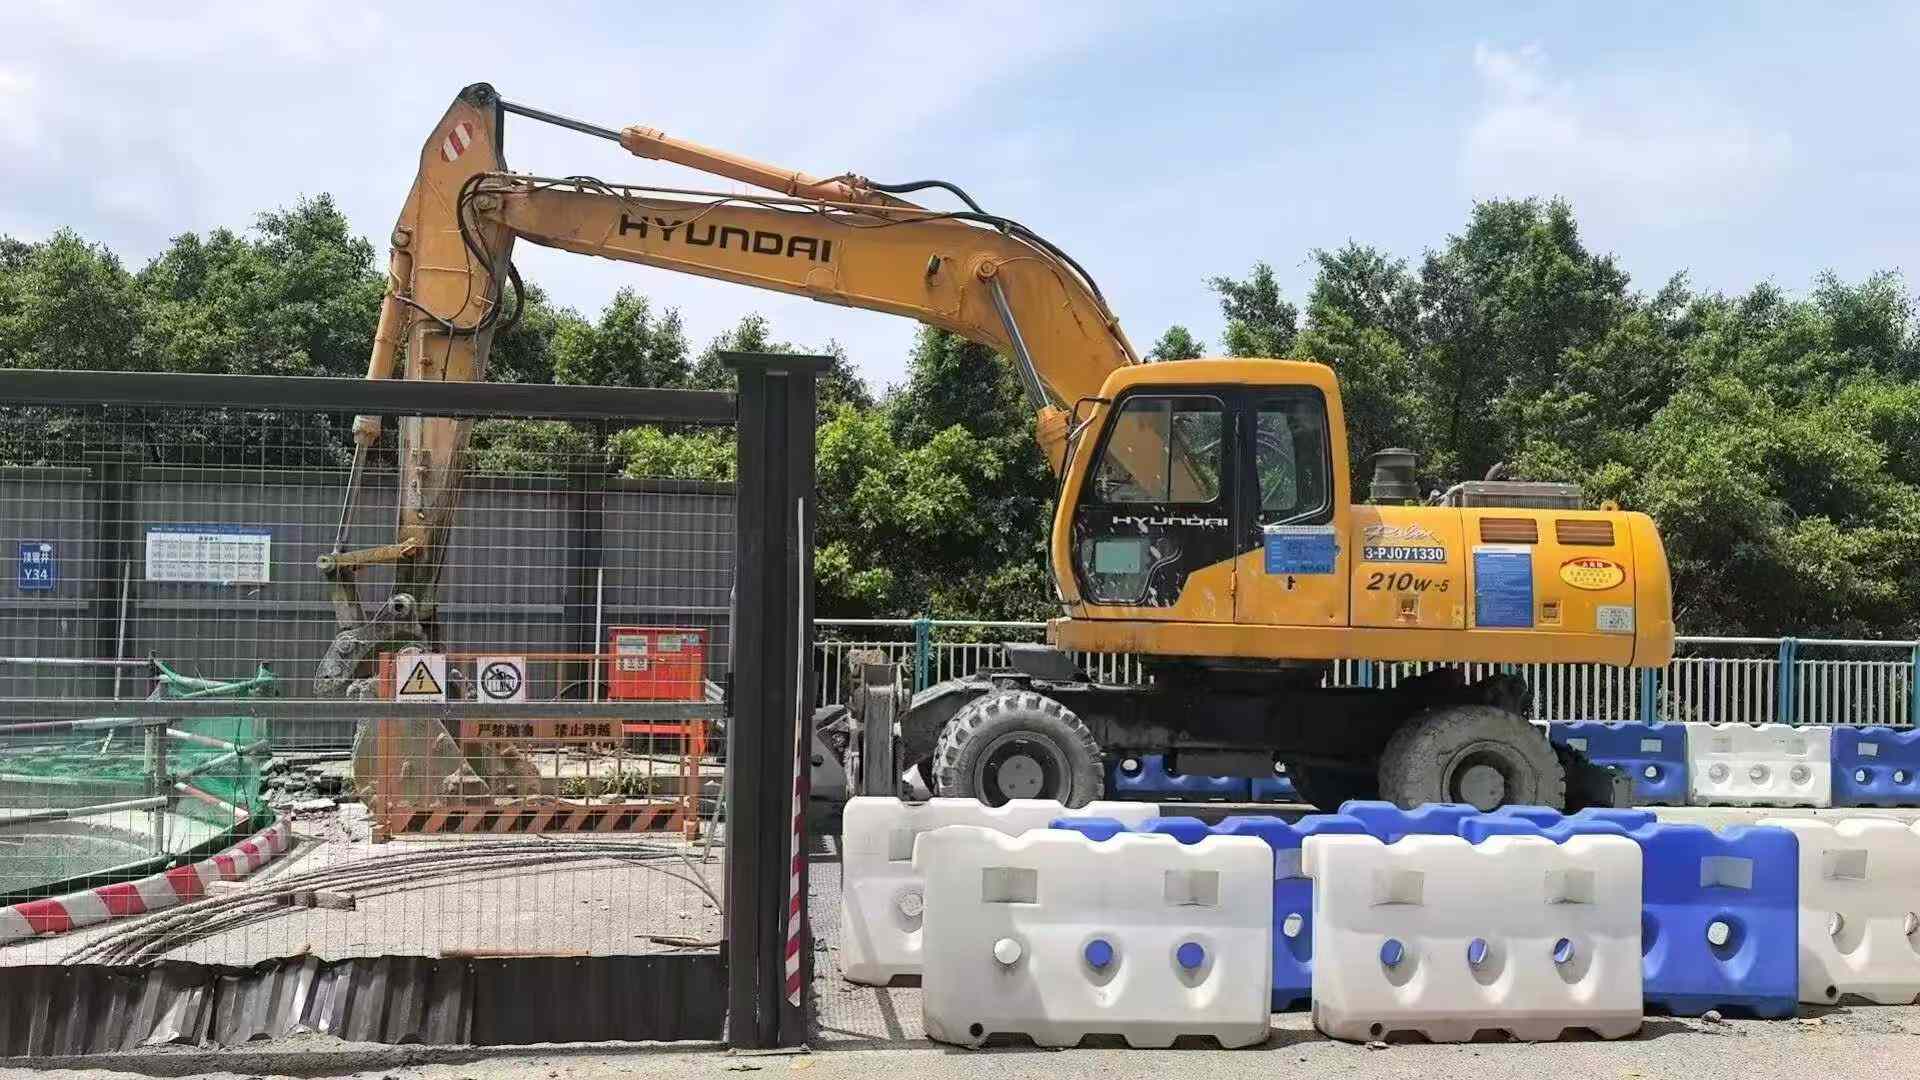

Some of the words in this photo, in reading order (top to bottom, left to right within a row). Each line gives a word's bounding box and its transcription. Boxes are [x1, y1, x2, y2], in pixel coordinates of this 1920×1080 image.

[619, 213, 832, 262] HYUNDAI
[1112, 515, 1229, 526] HYUNDAI
[1365, 547, 1444, 561] 3-PJ071330
[24, 568, 49, 581] Y34
[554, 722, 611, 738] 禁止跨越
